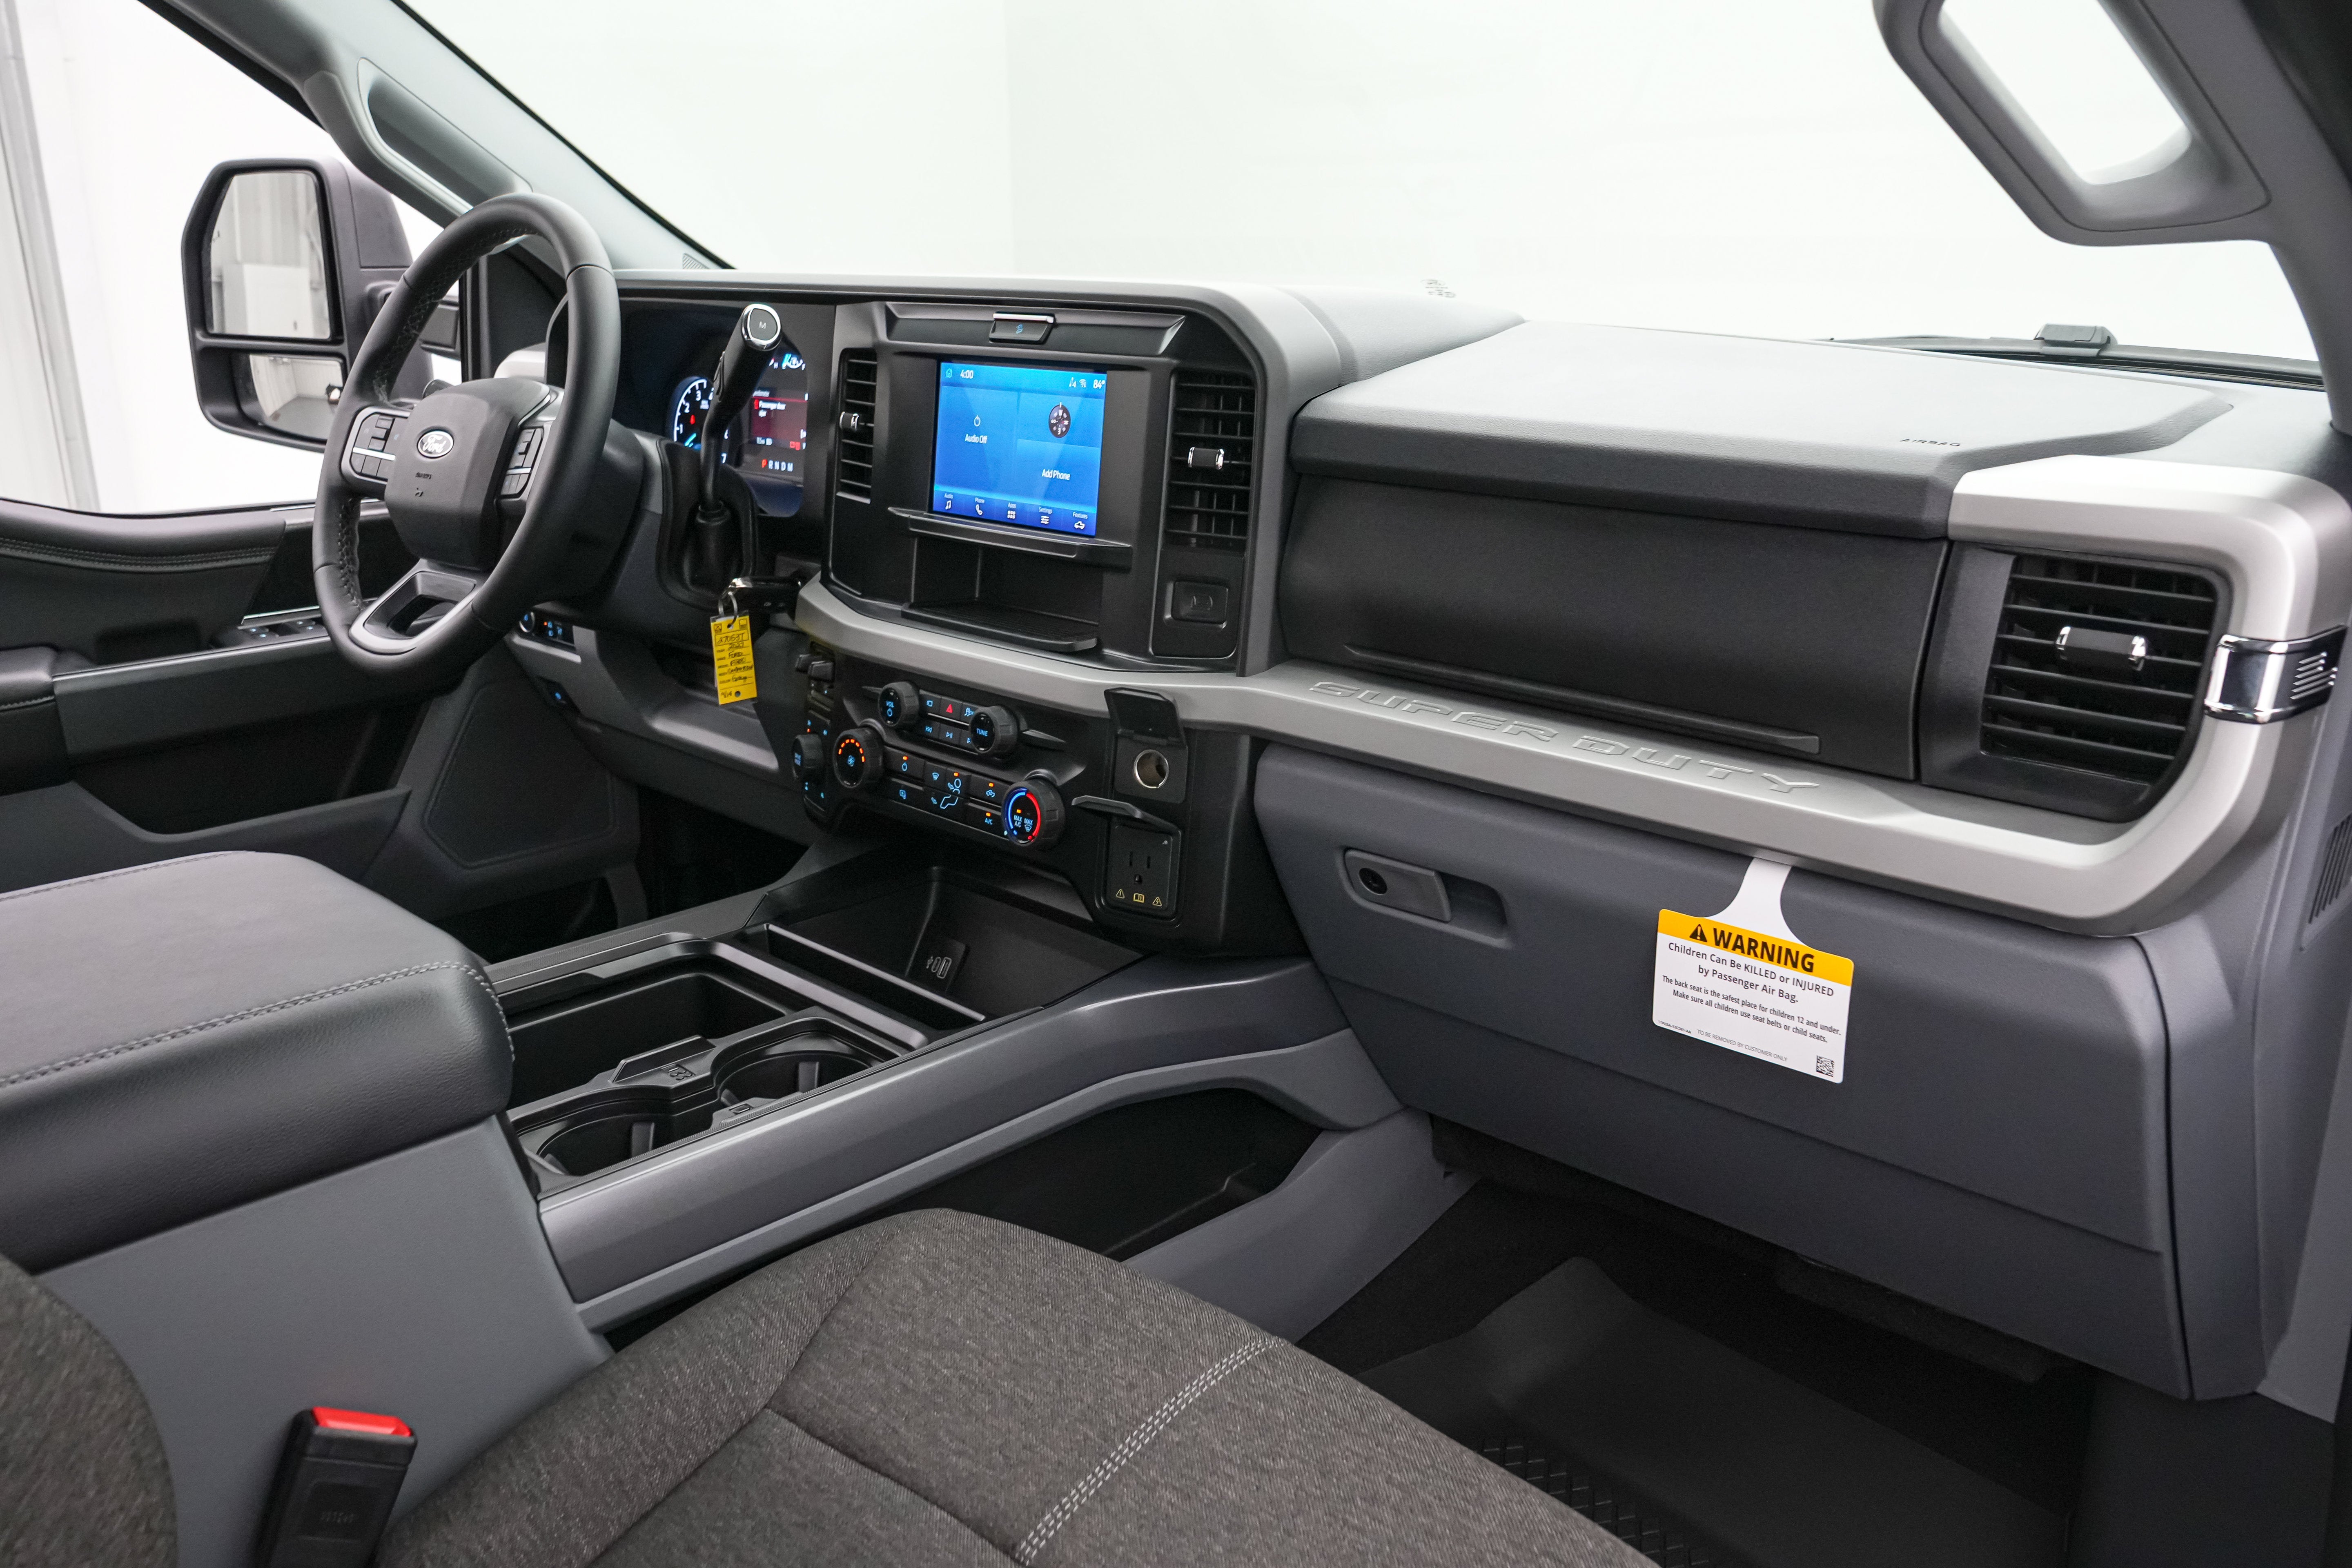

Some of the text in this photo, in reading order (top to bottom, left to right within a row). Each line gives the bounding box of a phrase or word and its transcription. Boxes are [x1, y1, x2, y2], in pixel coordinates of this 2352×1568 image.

[759, 321, 766, 329] M
[960, 369, 974, 379] 4:00
[696, 390, 702, 401] 3
[684, 402, 690, 413] 2
[679, 423, 683, 434] 1
[423, 434, 447, 453] Ford
[964, 434, 988, 444] Audio Off
[1899, 439, 1961, 447] AIRBAG
[721, 452, 727, 464] 7
[1042, 468, 1070, 481] Add Phone
[976, 728, 988, 737] TUNE
[1309, 681, 1820, 793] SUPER DUTY
[1713, 927, 1815, 973] WARNING
[1668, 942, 1834, 996] Children Can Be KILLED or INJURED
[1698, 964, 1798, 1004] by Passenger Air Bag.
[1662, 975, 1673, 984] The
[1675, 978, 1688, 989] back
[1689, 984, 1702, 993] seat
[1710, 989, 1720, 998] the
[1722, 994, 1740, 1004] safest
[1741, 999, 1757, 1010] place
[1759, 1004, 1768, 1013] for
[1770, 1008, 1795, 1021] children
[1797, 1016, 1804, 1024] 12
[1806, 1020, 1818, 1028] and
[1820, 1023, 1841, 1036] under.
[1673, 989, 1689, 1000] Make
[1690, 995, 1704, 1004] sure
[1714, 1002, 1739, 1015] children
[1740, 1011, 1751, 1019] use
[1753, 1014, 1765, 1024] seat
[1767, 1018, 1782, 1029] belts
[1792, 1026, 1807, 1036] child
[1809, 1032, 1828, 1043] seats.
[1712, 1034, 1736, 1046] REMOVED
[1744, 1045, 1773, 1057] CUSTOMER
[1773, 1054, 1788, 1062] ONLY
